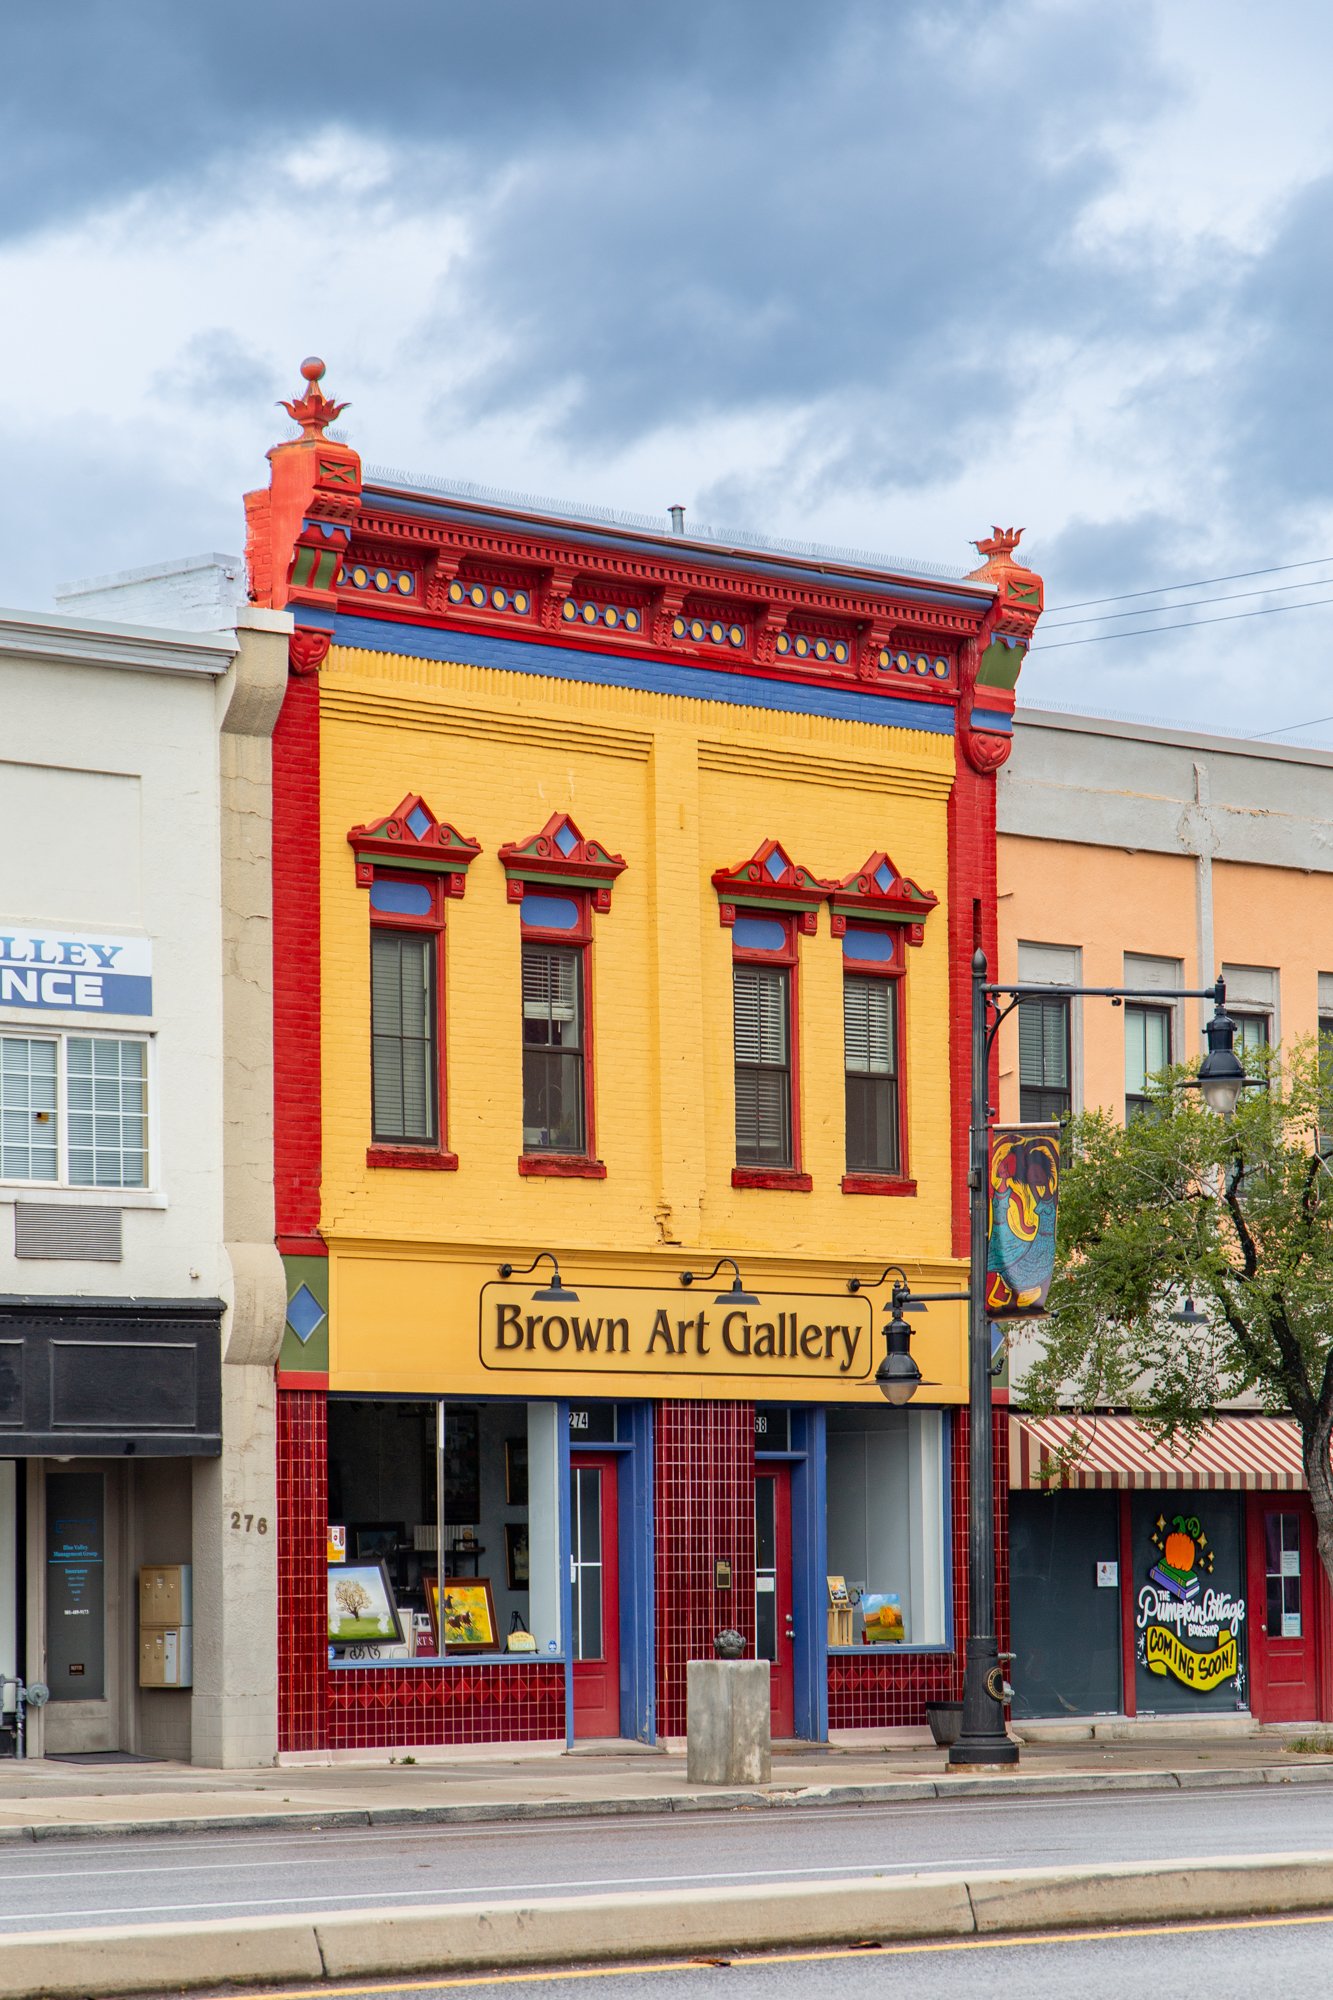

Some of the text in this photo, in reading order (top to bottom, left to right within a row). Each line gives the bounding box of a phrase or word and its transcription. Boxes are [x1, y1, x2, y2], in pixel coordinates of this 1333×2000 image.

[2, 968, 104, 1007] NCE
[495, 1303, 863, 1371] Brown Art Gallery
[569, 1412, 587, 1428] 274
[755, 1417, 766, 1432] 68
[231, 1511, 268, 1536] 276
[1157, 1590, 1171, 1602] THE
[1137, 1585, 1245, 1637] Pumpkin Cottage
[1188, 1624, 1219, 1638] BOOKSHOP
[1150, 1628, 1234, 1681] COMING SOON!
